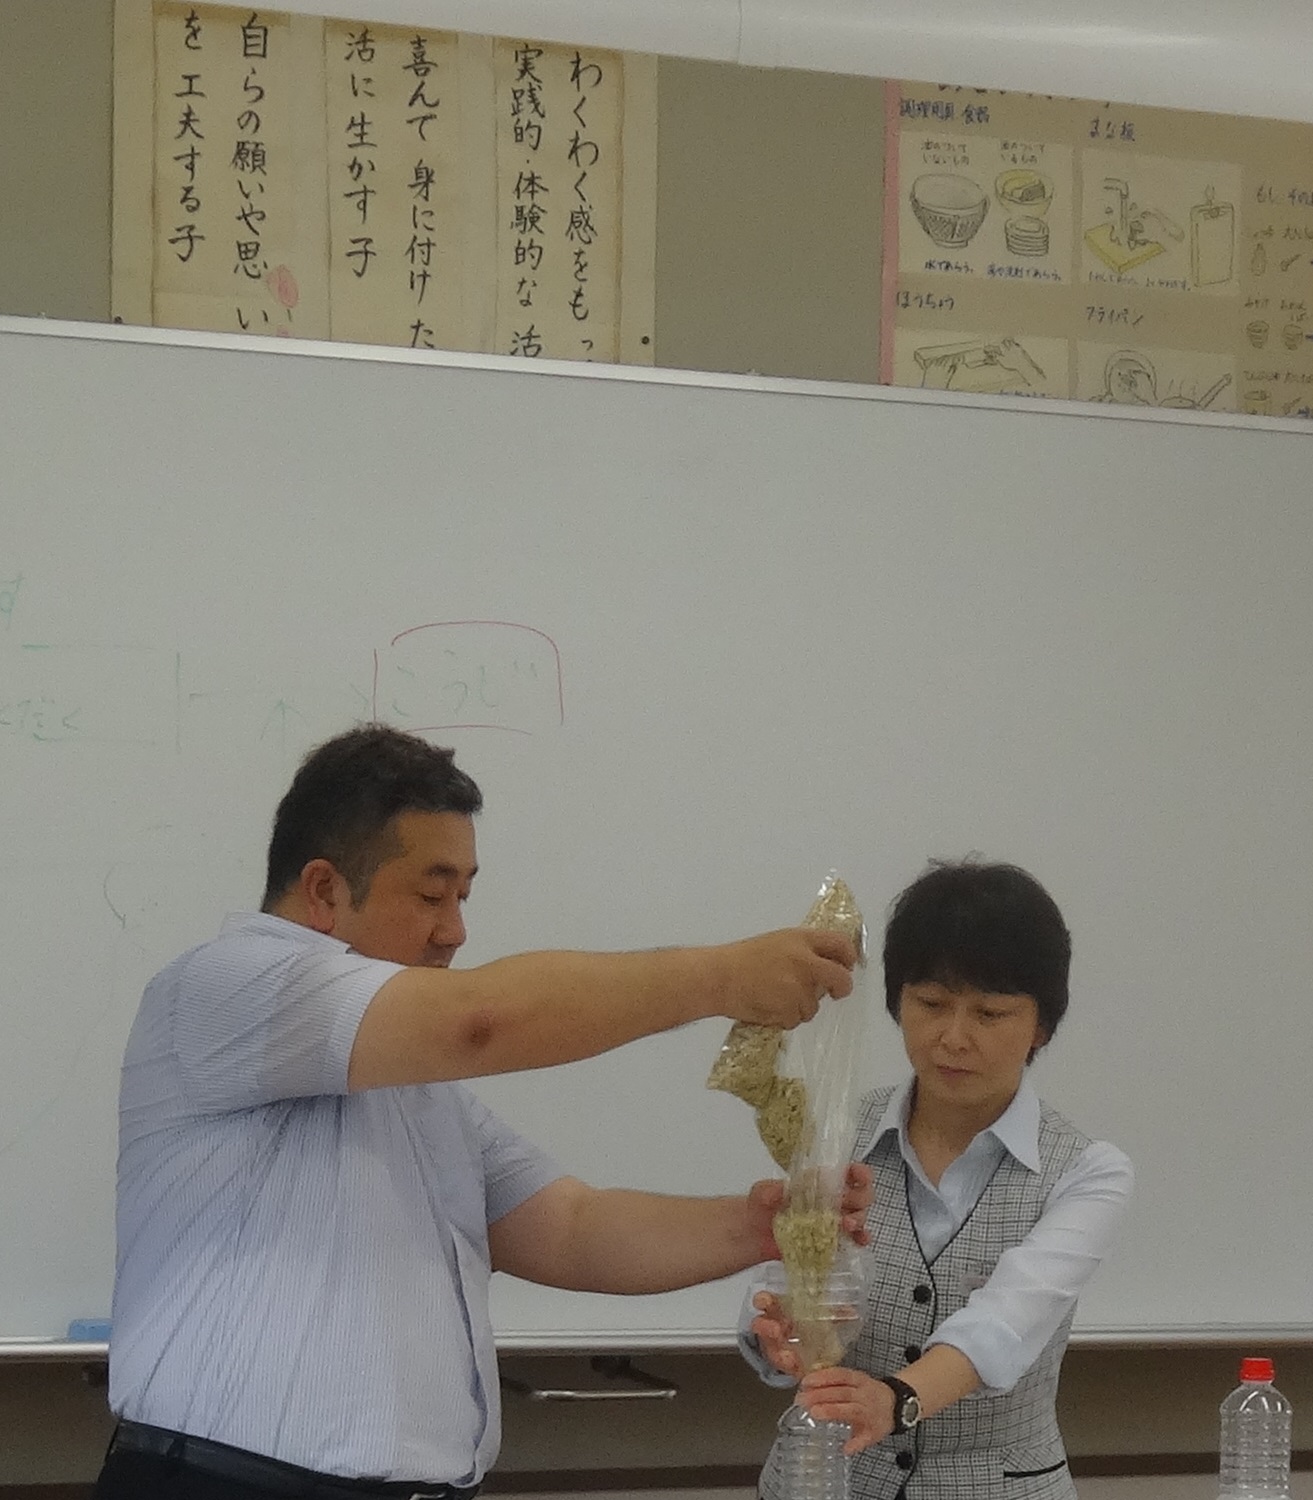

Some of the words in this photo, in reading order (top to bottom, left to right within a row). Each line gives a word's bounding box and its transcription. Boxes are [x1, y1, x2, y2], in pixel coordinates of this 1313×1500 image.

[167, 9, 207, 263] を工夫する子
[232, 12, 270, 330] 自らの願いや思い
[344, 28, 377, 278] 活に生かす子
[404, 35, 440, 349] 喜んで身に付けた
[565, 52, 603, 361] わくわく感をもっ
